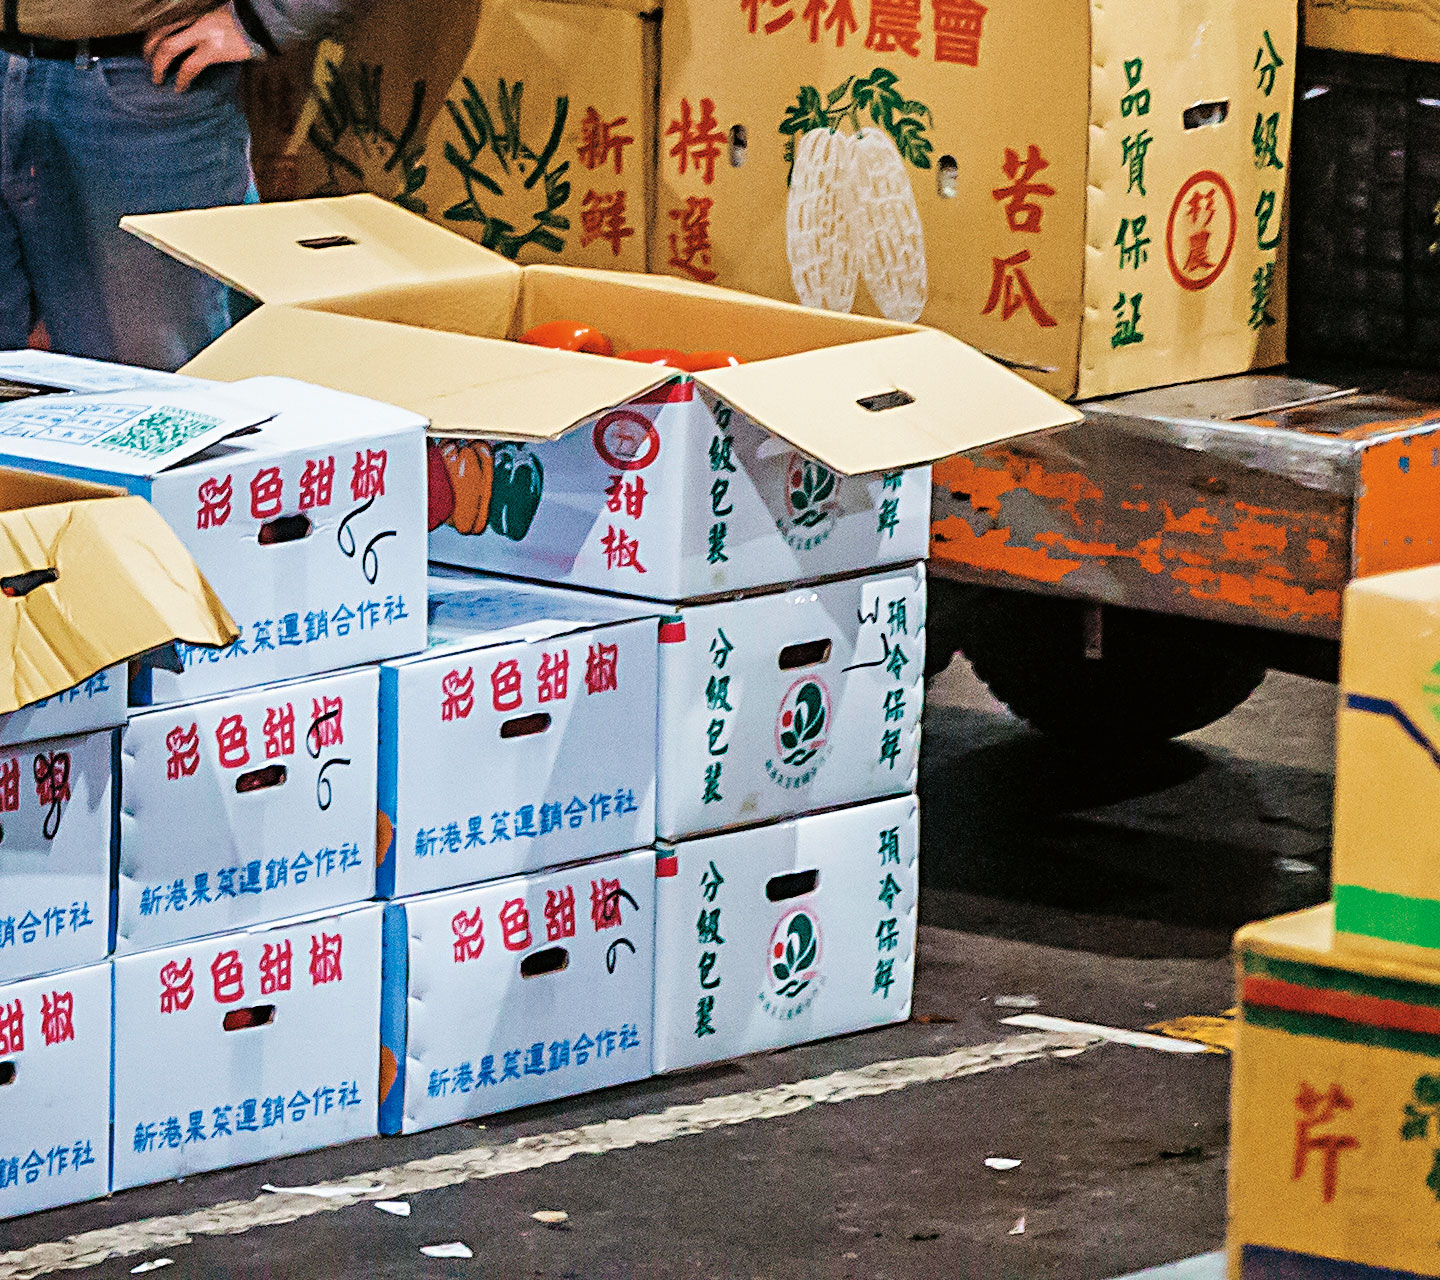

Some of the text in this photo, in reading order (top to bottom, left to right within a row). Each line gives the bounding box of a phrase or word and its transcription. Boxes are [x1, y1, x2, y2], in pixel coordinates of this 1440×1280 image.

[578, 109, 633, 254] 新鮮
[665, 98, 727, 282] 特選
[1110, 57, 1152, 347] 品質保証
[1249, 31, 1284, 328] 分級包裝
[984, 145, 1056, 327] 苦瓜
[197, 450, 387, 529] 彩色甜椒
[601, 475, 647, 573] 甜椒
[442, 644, 618, 721] 彩色甜椒
[702, 628, 733, 804] 分級包裝
[879, 598, 910, 769] 預冷保鮮
[166, 697, 343, 779] 彩色甜椒
[414, 789, 639, 857] 新港果菜運銷合作社
[139, 843, 363, 916] 新港果菜運銷合作社
[452, 879, 621, 962] 彩色甜椒
[873, 827, 902, 1000] 預冷保鮮
[160, 934, 342, 1013] 彩色甜椒
[695, 860, 726, 1037] 分級包裝
[427, 1025, 641, 1099] 新港果菜運銷合作社
[133, 1081, 362, 1153] 新港果菜運銷合作社
[1292, 1082, 1358, 1203] 芹
